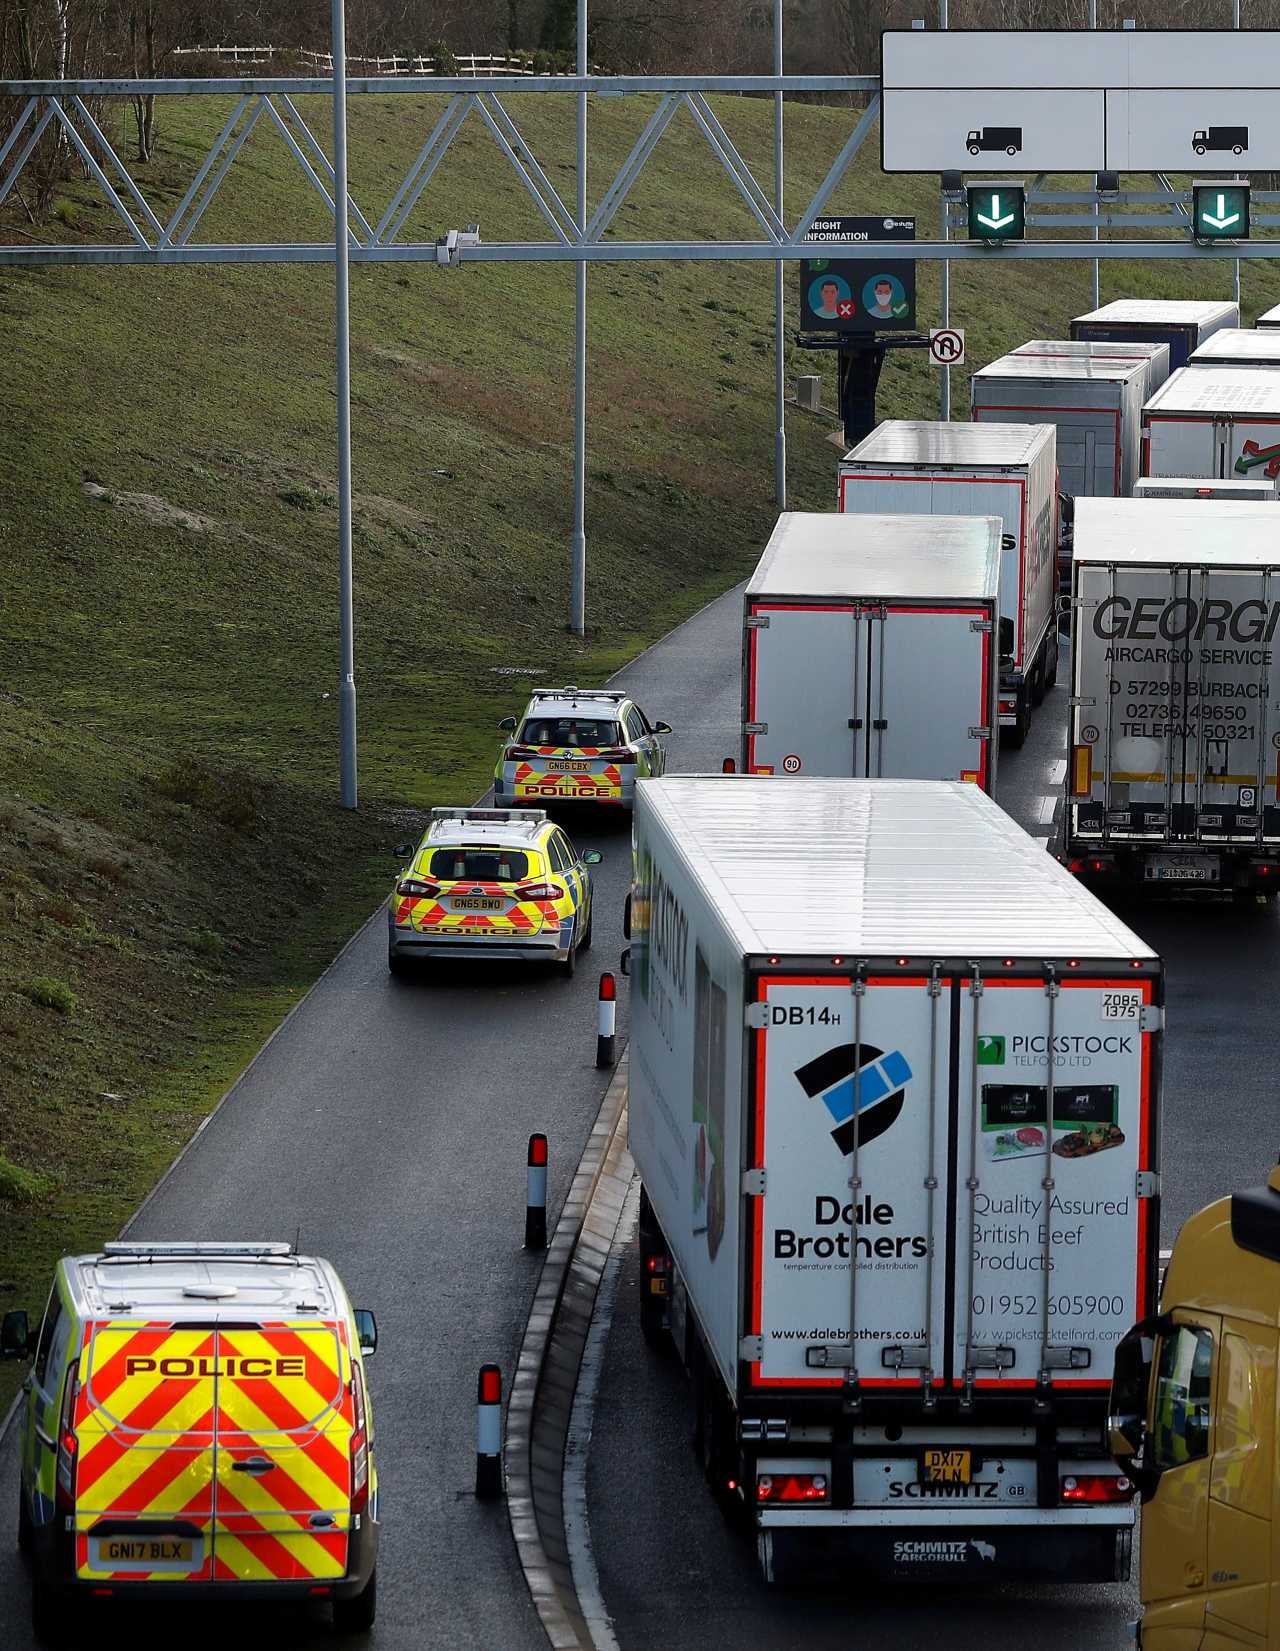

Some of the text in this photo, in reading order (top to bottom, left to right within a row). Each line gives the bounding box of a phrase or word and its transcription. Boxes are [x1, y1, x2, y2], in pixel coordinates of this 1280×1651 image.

[804, 232, 868, 241] INFORMATION
[1104, 647, 1272, 666] AIRCARGO SERVICE
[1127, 681, 1182, 697] 57299
[1185, 682, 1270, 699] BURBACH
[1120, 722, 1255, 740] TELEFAX 50321
[548, 761, 570, 770] GN66
[786, 759, 798, 769] 90
[525, 786, 610, 797] POLICE
[454, 899, 479, 909] GN65
[422, 926, 531, 936] POLICE
[772, 1006, 841, 1026] DB14H
[1105, 1006, 1136, 1018] 1375
[1012, 1036, 1133, 1054] PICKSTOCK
[1014, 1055, 1092, 1067] TELFORD LTD
[815, 1195, 894, 1226] Dale
[973, 1193, 1129, 1220] Quality Assured
[972, 1223, 1030, 1244] British
[774, 1229, 928, 1259] Brothers
[783, 1263, 832, 1272] temperature
[874, 1262, 919, 1271] distribution
[973, 1250, 1055, 1271] Products
[972, 1295, 1124, 1316] 01952 605900
[771, 1328, 928, 1340] www.dalebrothers.co.uk
[126, 1358, 304, 1377] POLICE
[931, 1453, 964, 1466] DX17
[933, 1468, 962, 1482] ZLN
[889, 1482, 1025, 1498] SCHMITZ GB
[109, 1543, 183, 1559] GN17 BLX
[894, 1541, 967, 1553] SCHMITZ
[894, 1553, 967, 1562] CARGOBULL
